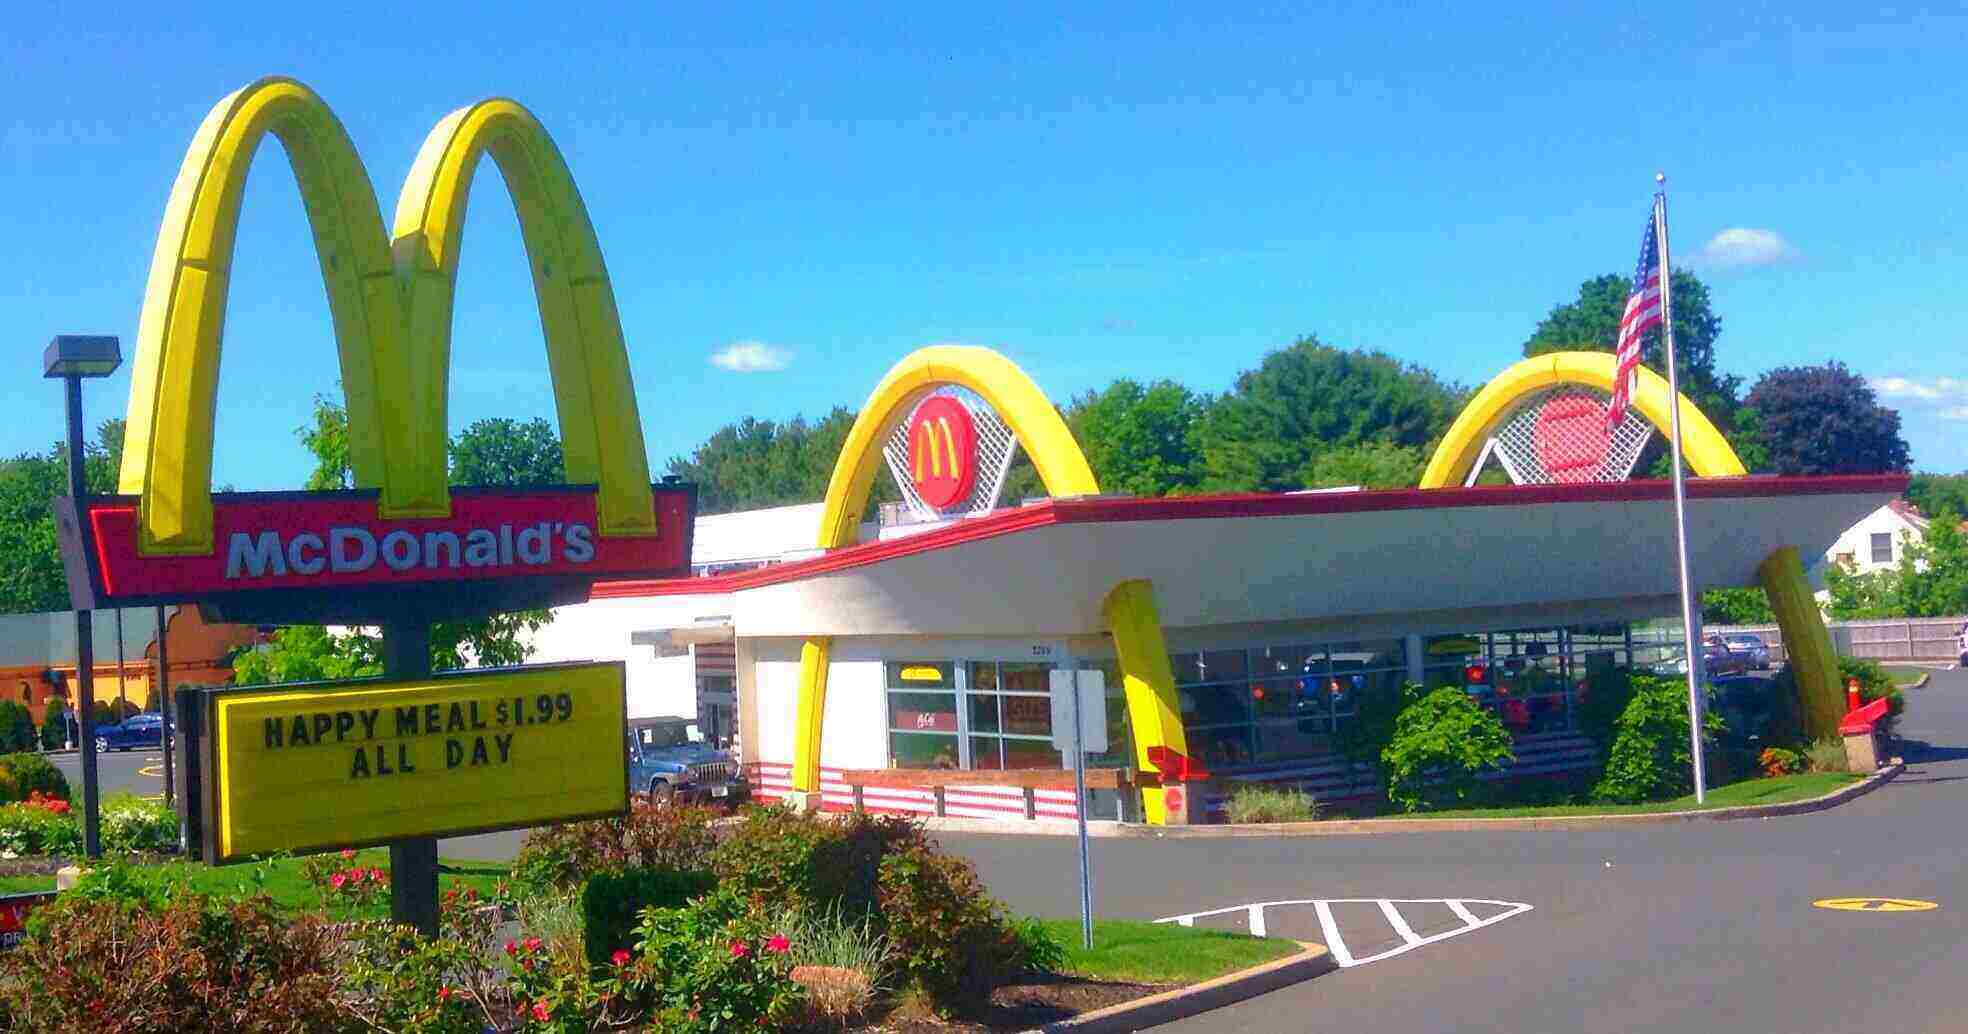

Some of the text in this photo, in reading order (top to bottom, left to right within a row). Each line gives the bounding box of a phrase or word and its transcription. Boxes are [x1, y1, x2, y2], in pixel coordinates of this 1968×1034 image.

[226, 522, 595, 579] McDonald's
[264, 693, 573, 748] HAPPY MEAL $1.99
[351, 733, 513, 779] ALL DAY
